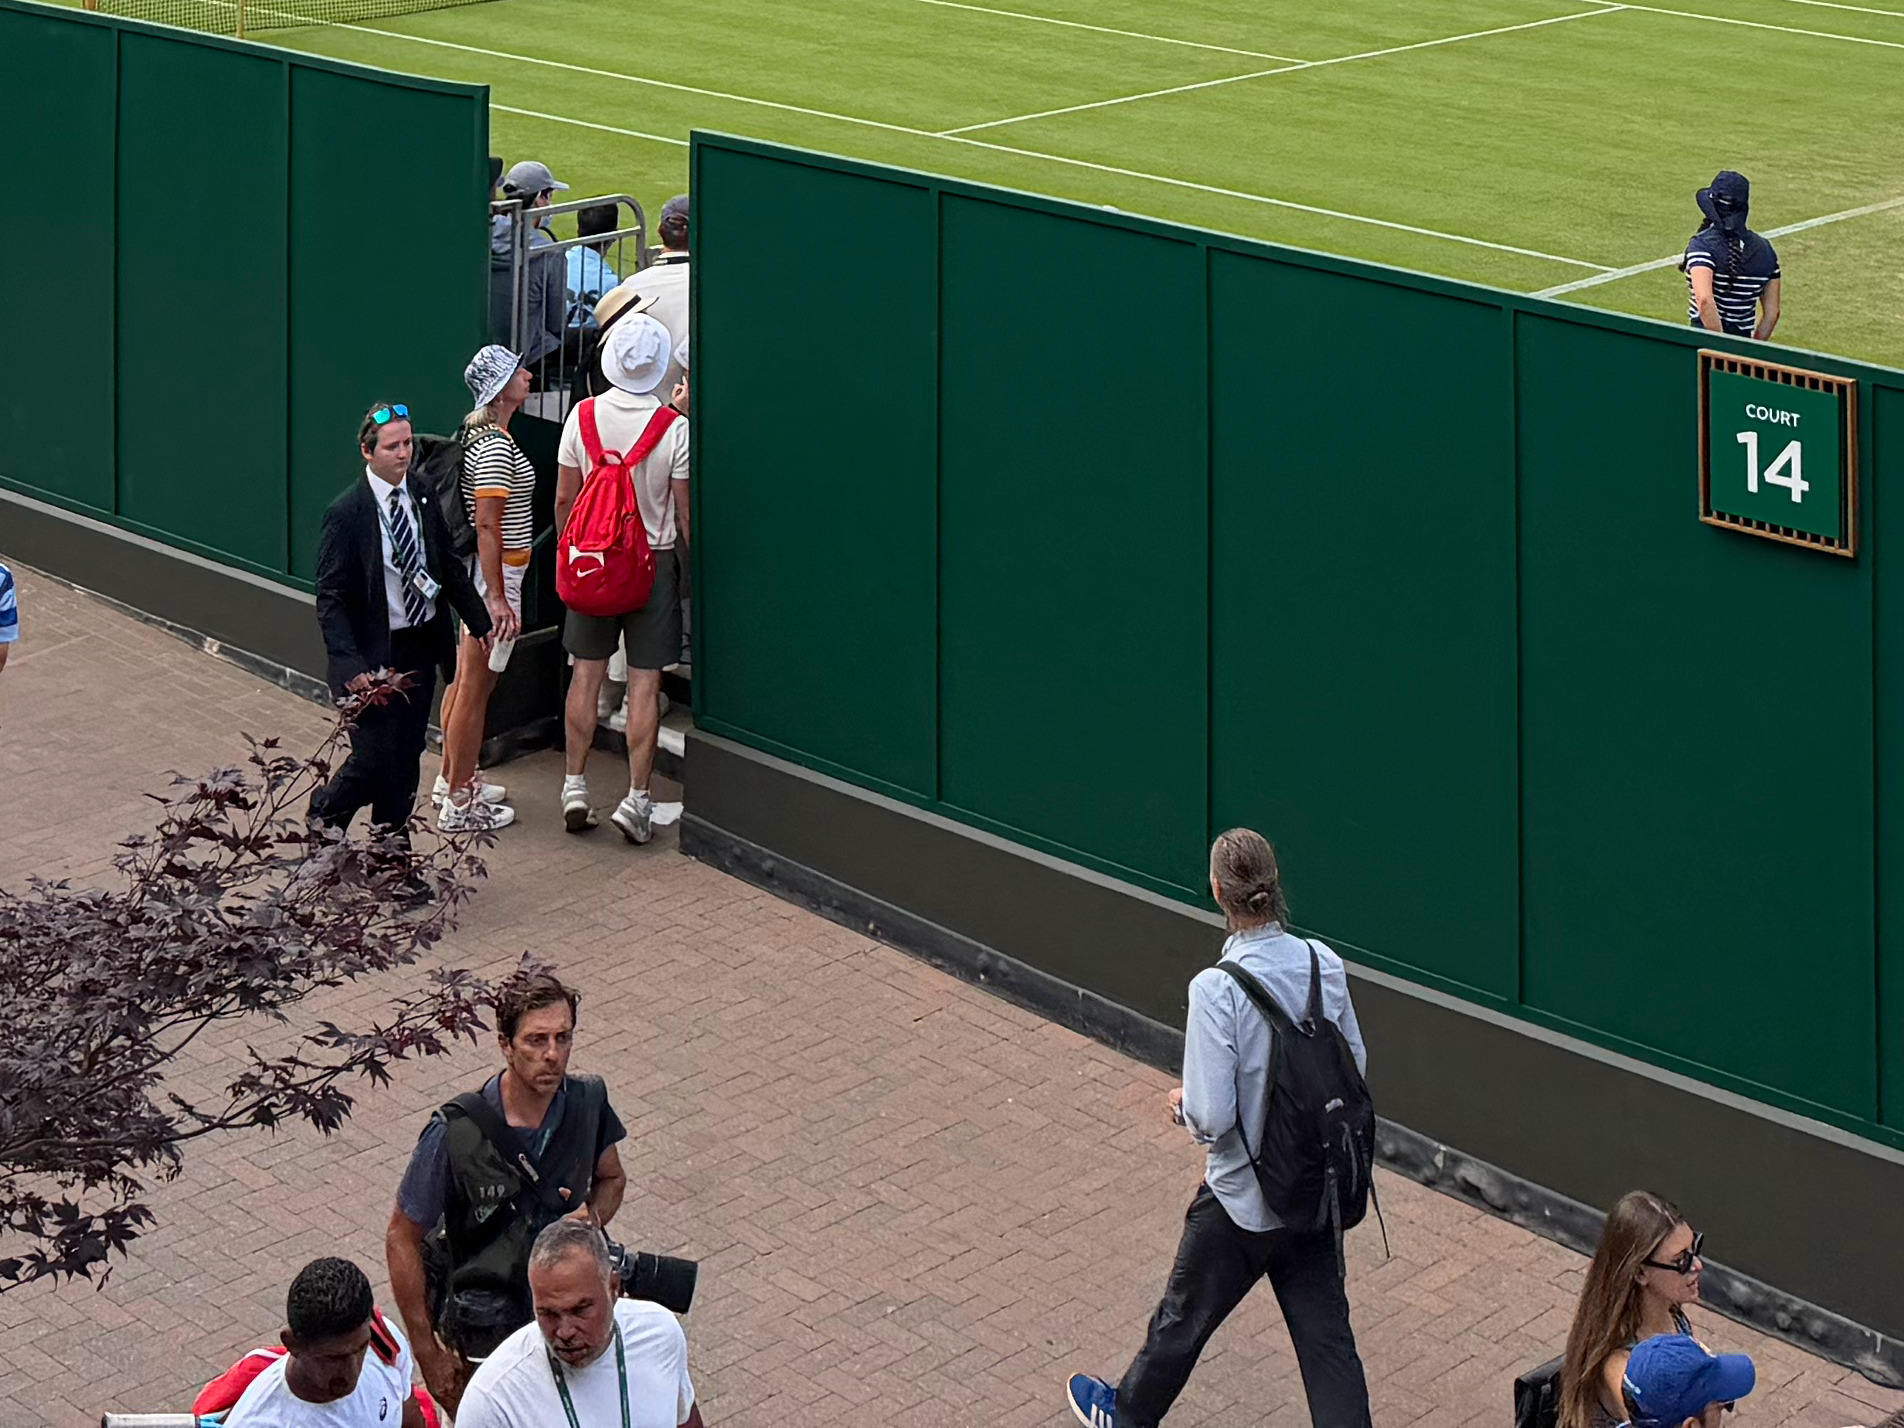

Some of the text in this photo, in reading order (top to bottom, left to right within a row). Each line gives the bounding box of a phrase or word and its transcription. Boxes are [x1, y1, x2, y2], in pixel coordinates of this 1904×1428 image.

[1745, 403, 1801, 428] COURT
[1736, 430, 1810, 504] 14
[479, 1184, 505, 1199] 149
